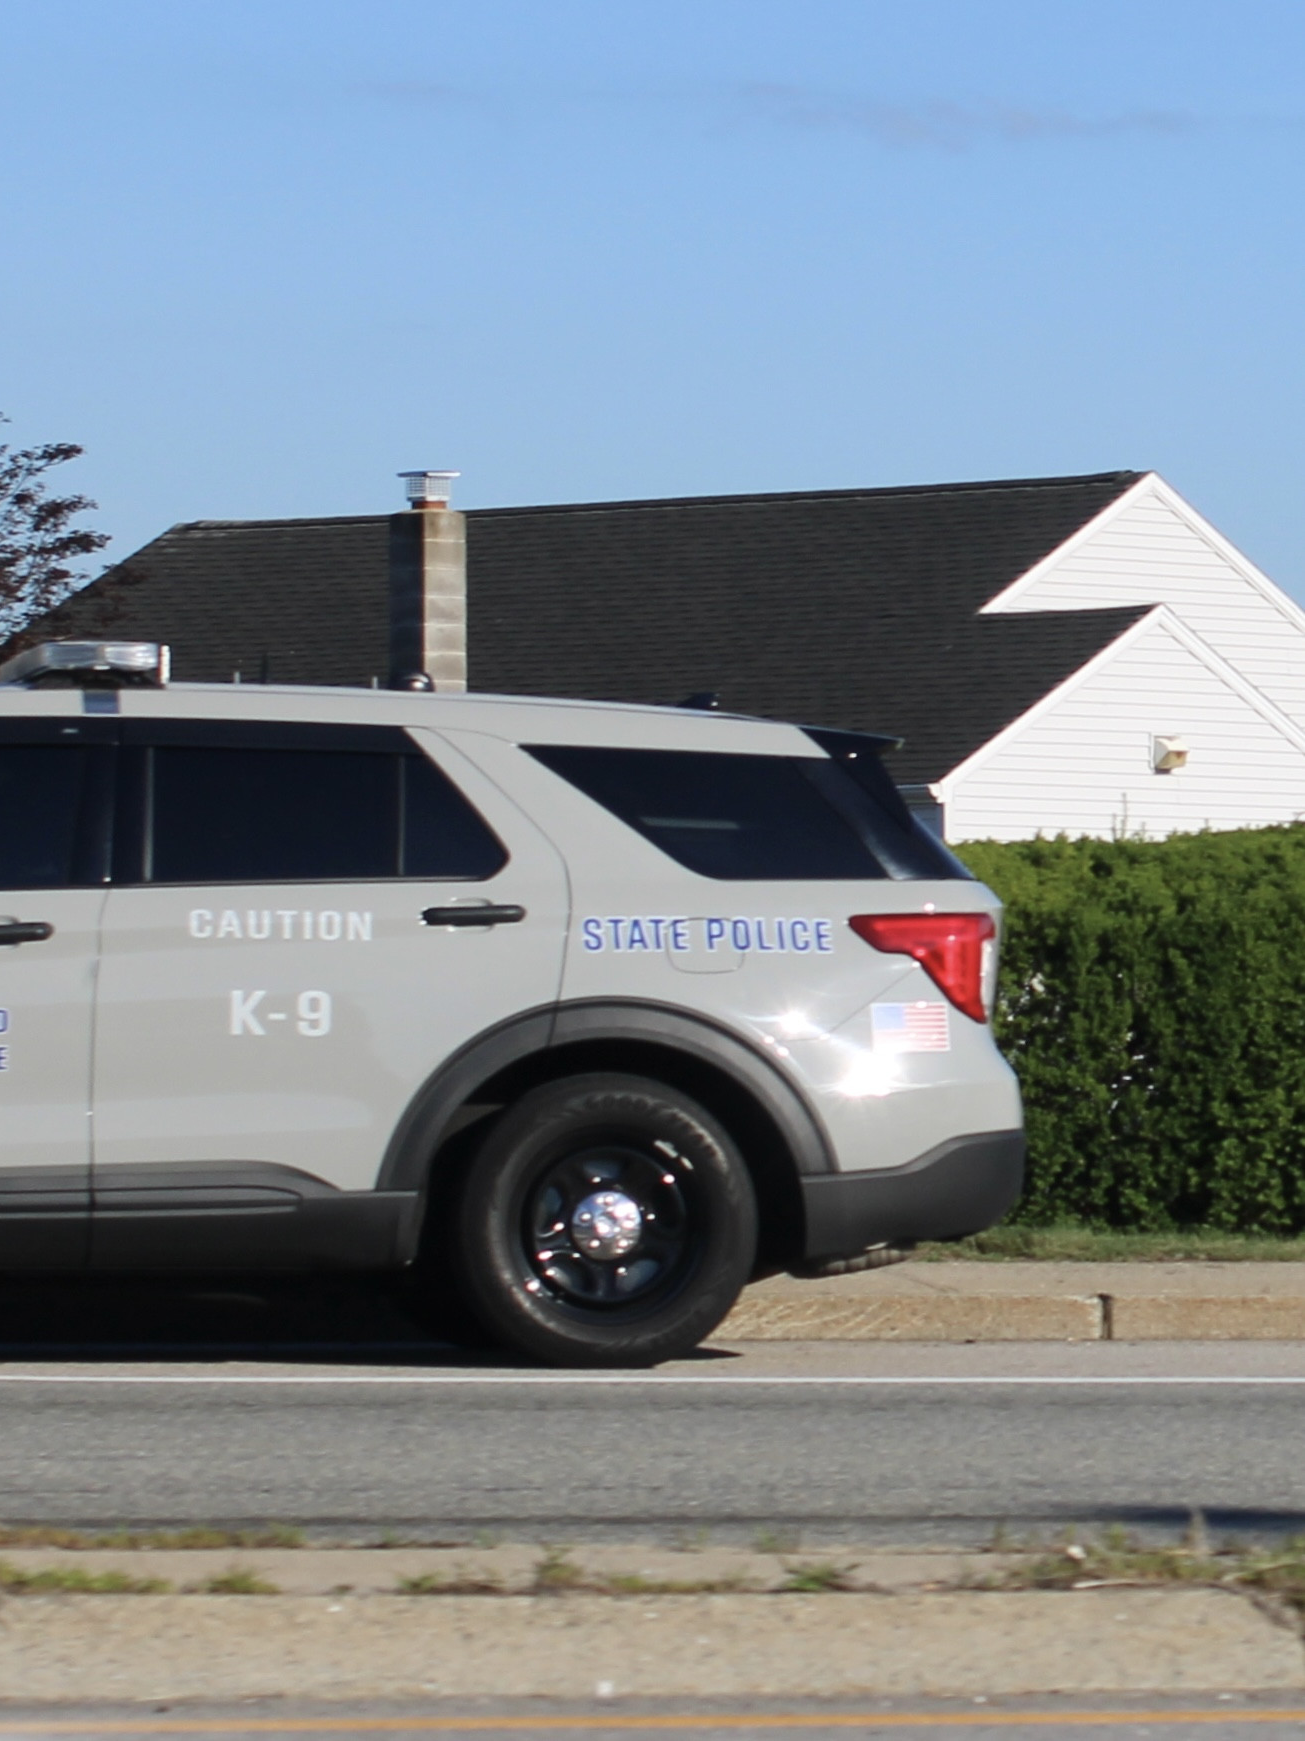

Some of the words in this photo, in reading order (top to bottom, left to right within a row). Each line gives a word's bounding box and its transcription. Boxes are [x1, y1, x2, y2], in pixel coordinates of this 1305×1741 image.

[189, 909, 373, 941] CAUTION
[583, 918, 688, 950] STATE
[706, 918, 832, 951] POLICE
[229, 989, 333, 1036] K-9
